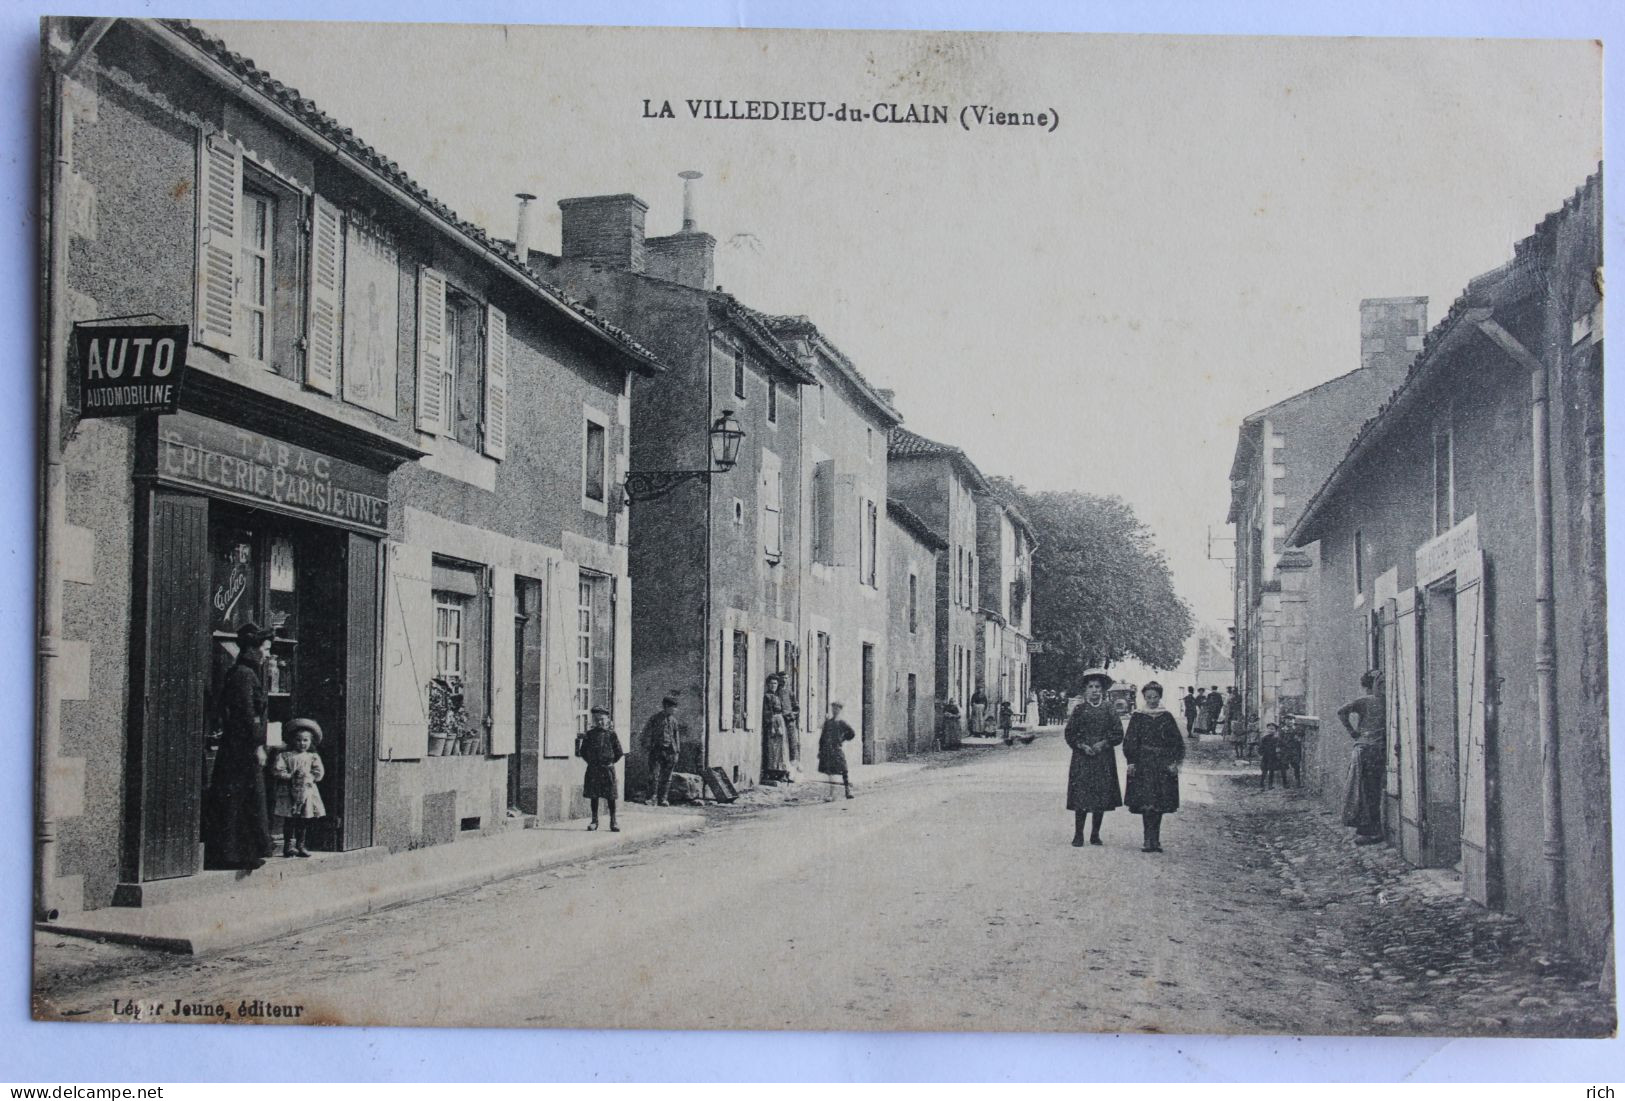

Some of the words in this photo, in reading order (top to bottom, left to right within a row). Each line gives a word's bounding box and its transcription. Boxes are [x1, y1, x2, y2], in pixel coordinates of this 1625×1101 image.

[87, 337, 177, 380] AUTO
[86, 384, 174, 408] AUTOMOBILINE
[236, 429, 330, 479] TABAC
[270, 465, 383, 525] PARISIENNE
[213, 567, 247, 621] Tabac
